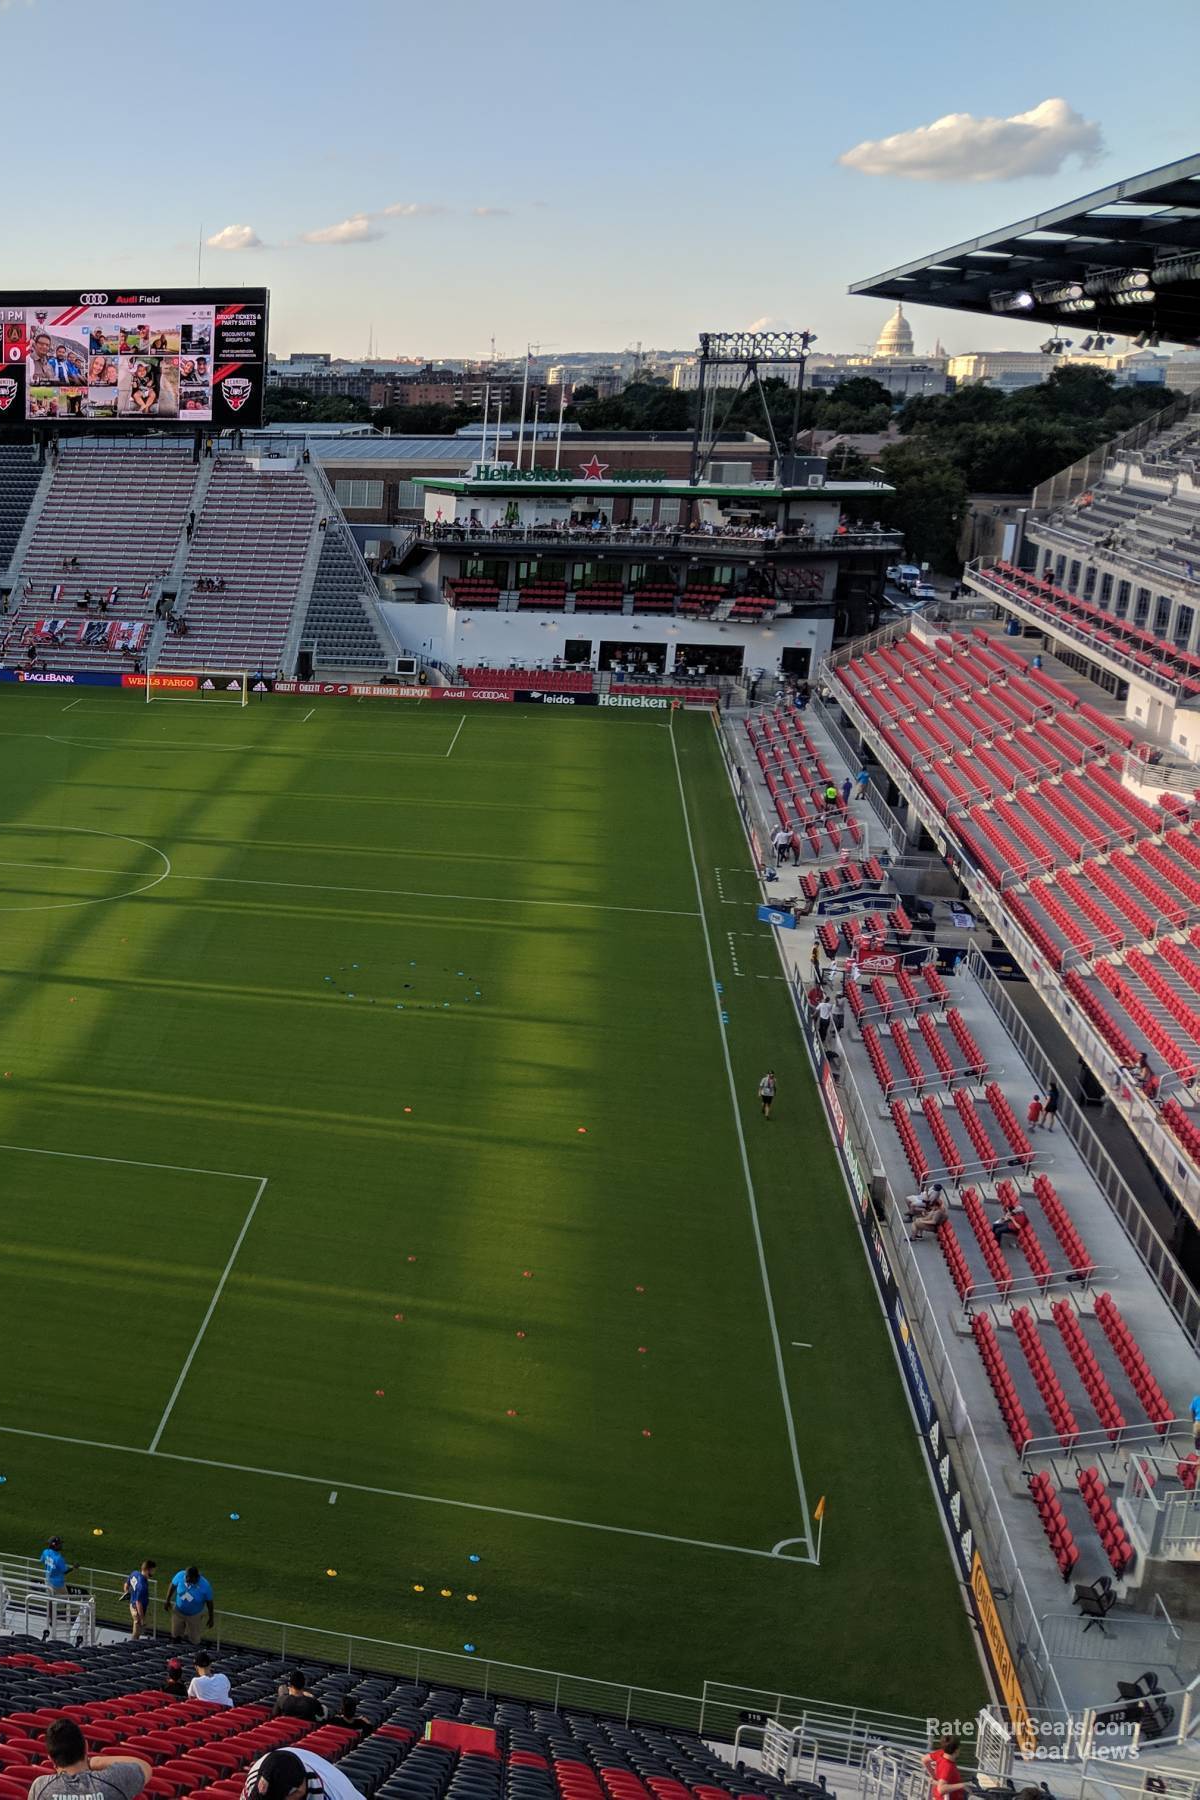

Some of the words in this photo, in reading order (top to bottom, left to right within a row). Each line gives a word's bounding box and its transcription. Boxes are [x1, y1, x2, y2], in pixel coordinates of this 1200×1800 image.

[8, 311, 23, 320] PM
[94, 311, 146, 319] #UnitedAtHome
[9, 347, 21, 361] 0
[24, 672, 74, 683] EAGLEBANK
[128, 677, 160, 686] WELLS
[162, 679, 194, 687] FARGO
[353, 687, 370, 695] THE
[373, 687, 398, 696] HOME
[400, 688, 429, 697] DEPOT
[543, 694, 575, 704] leidos
[599, 694, 667, 708] Heineken
